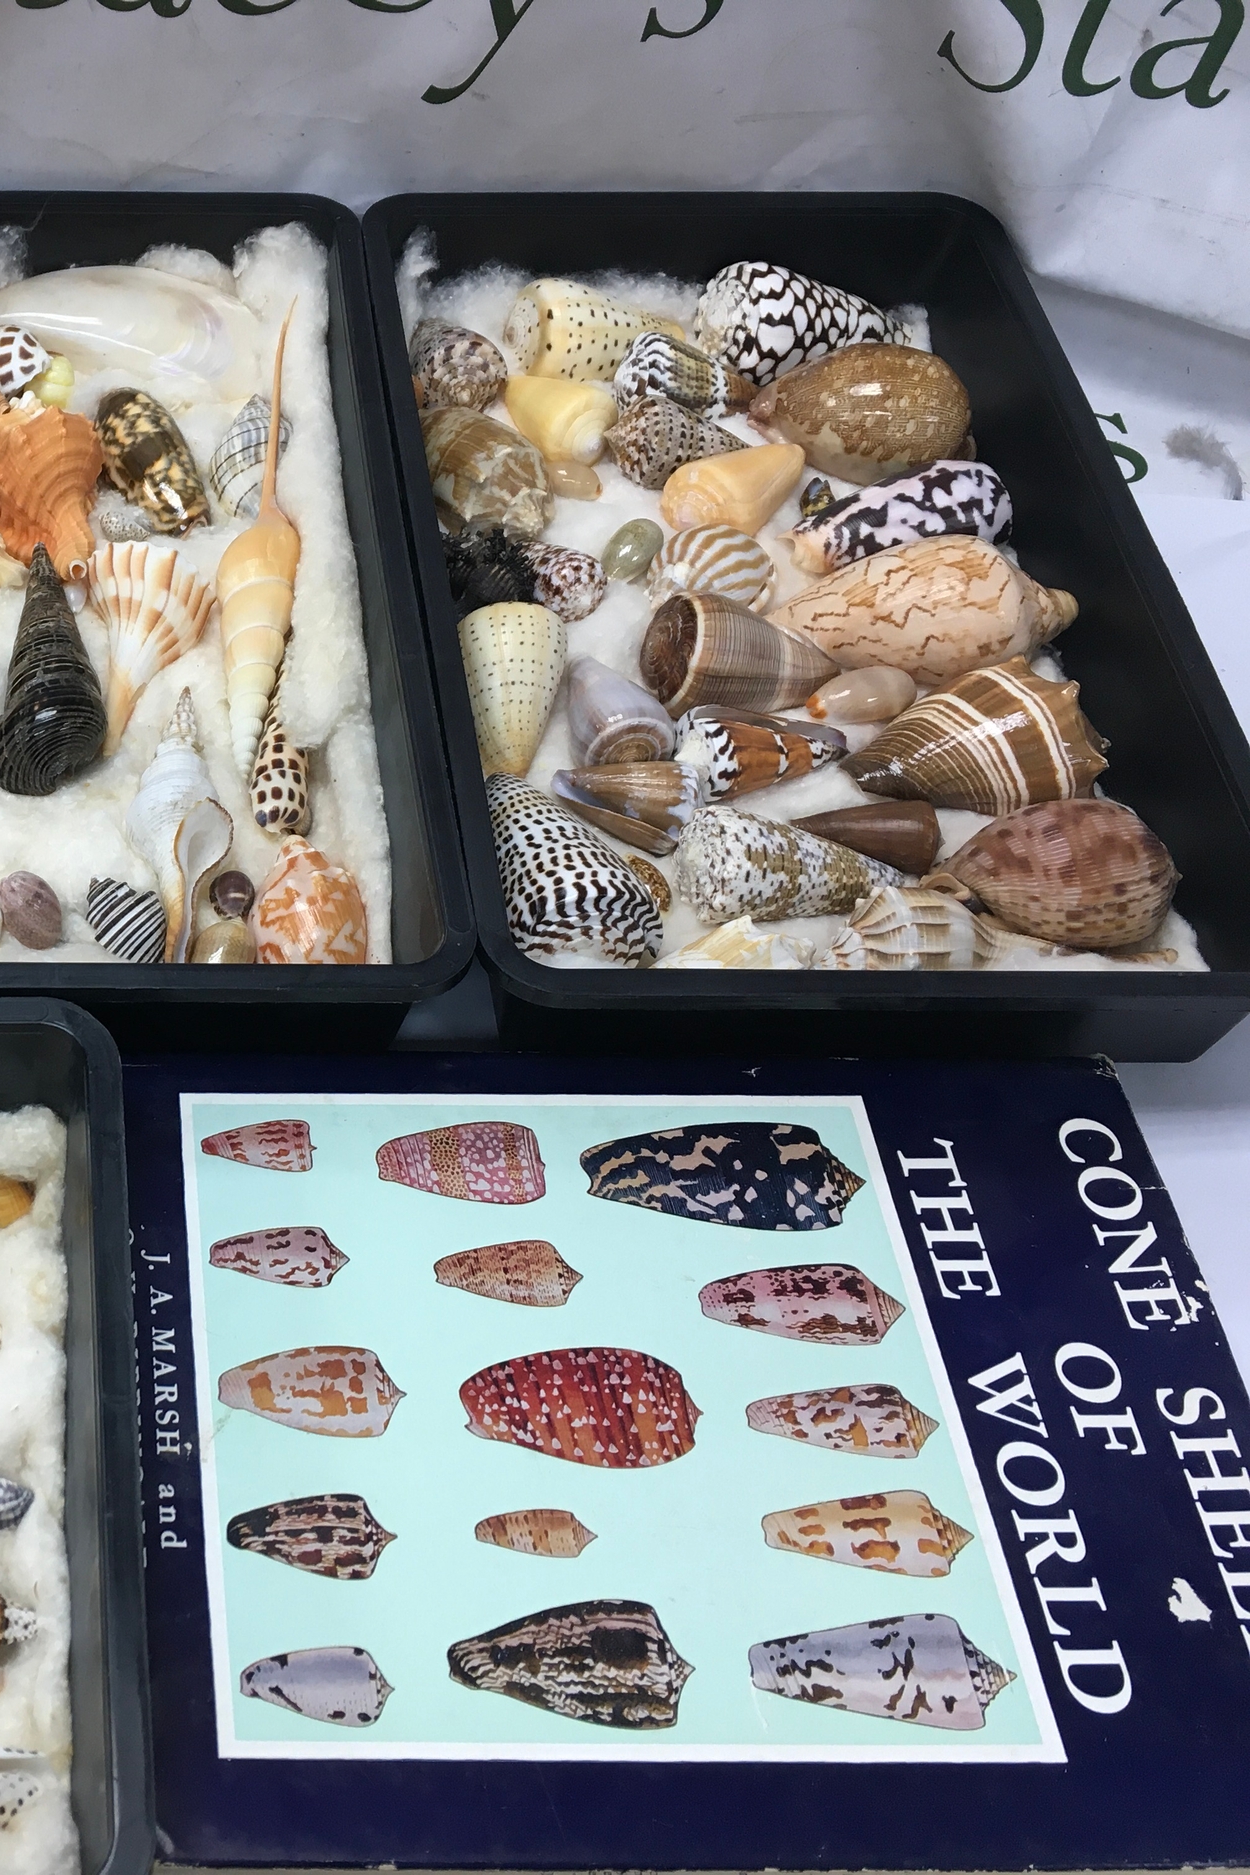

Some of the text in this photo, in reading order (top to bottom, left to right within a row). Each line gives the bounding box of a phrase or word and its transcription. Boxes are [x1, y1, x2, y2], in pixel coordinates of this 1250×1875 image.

[141, 1250, 187, 1550] J. A. MARSH and
[897, 1137, 1133, 1715] THE WORLD
[1055, 1342, 1147, 1456] OF
[1058, 1117, 1250, 1654] CONE SHEL
